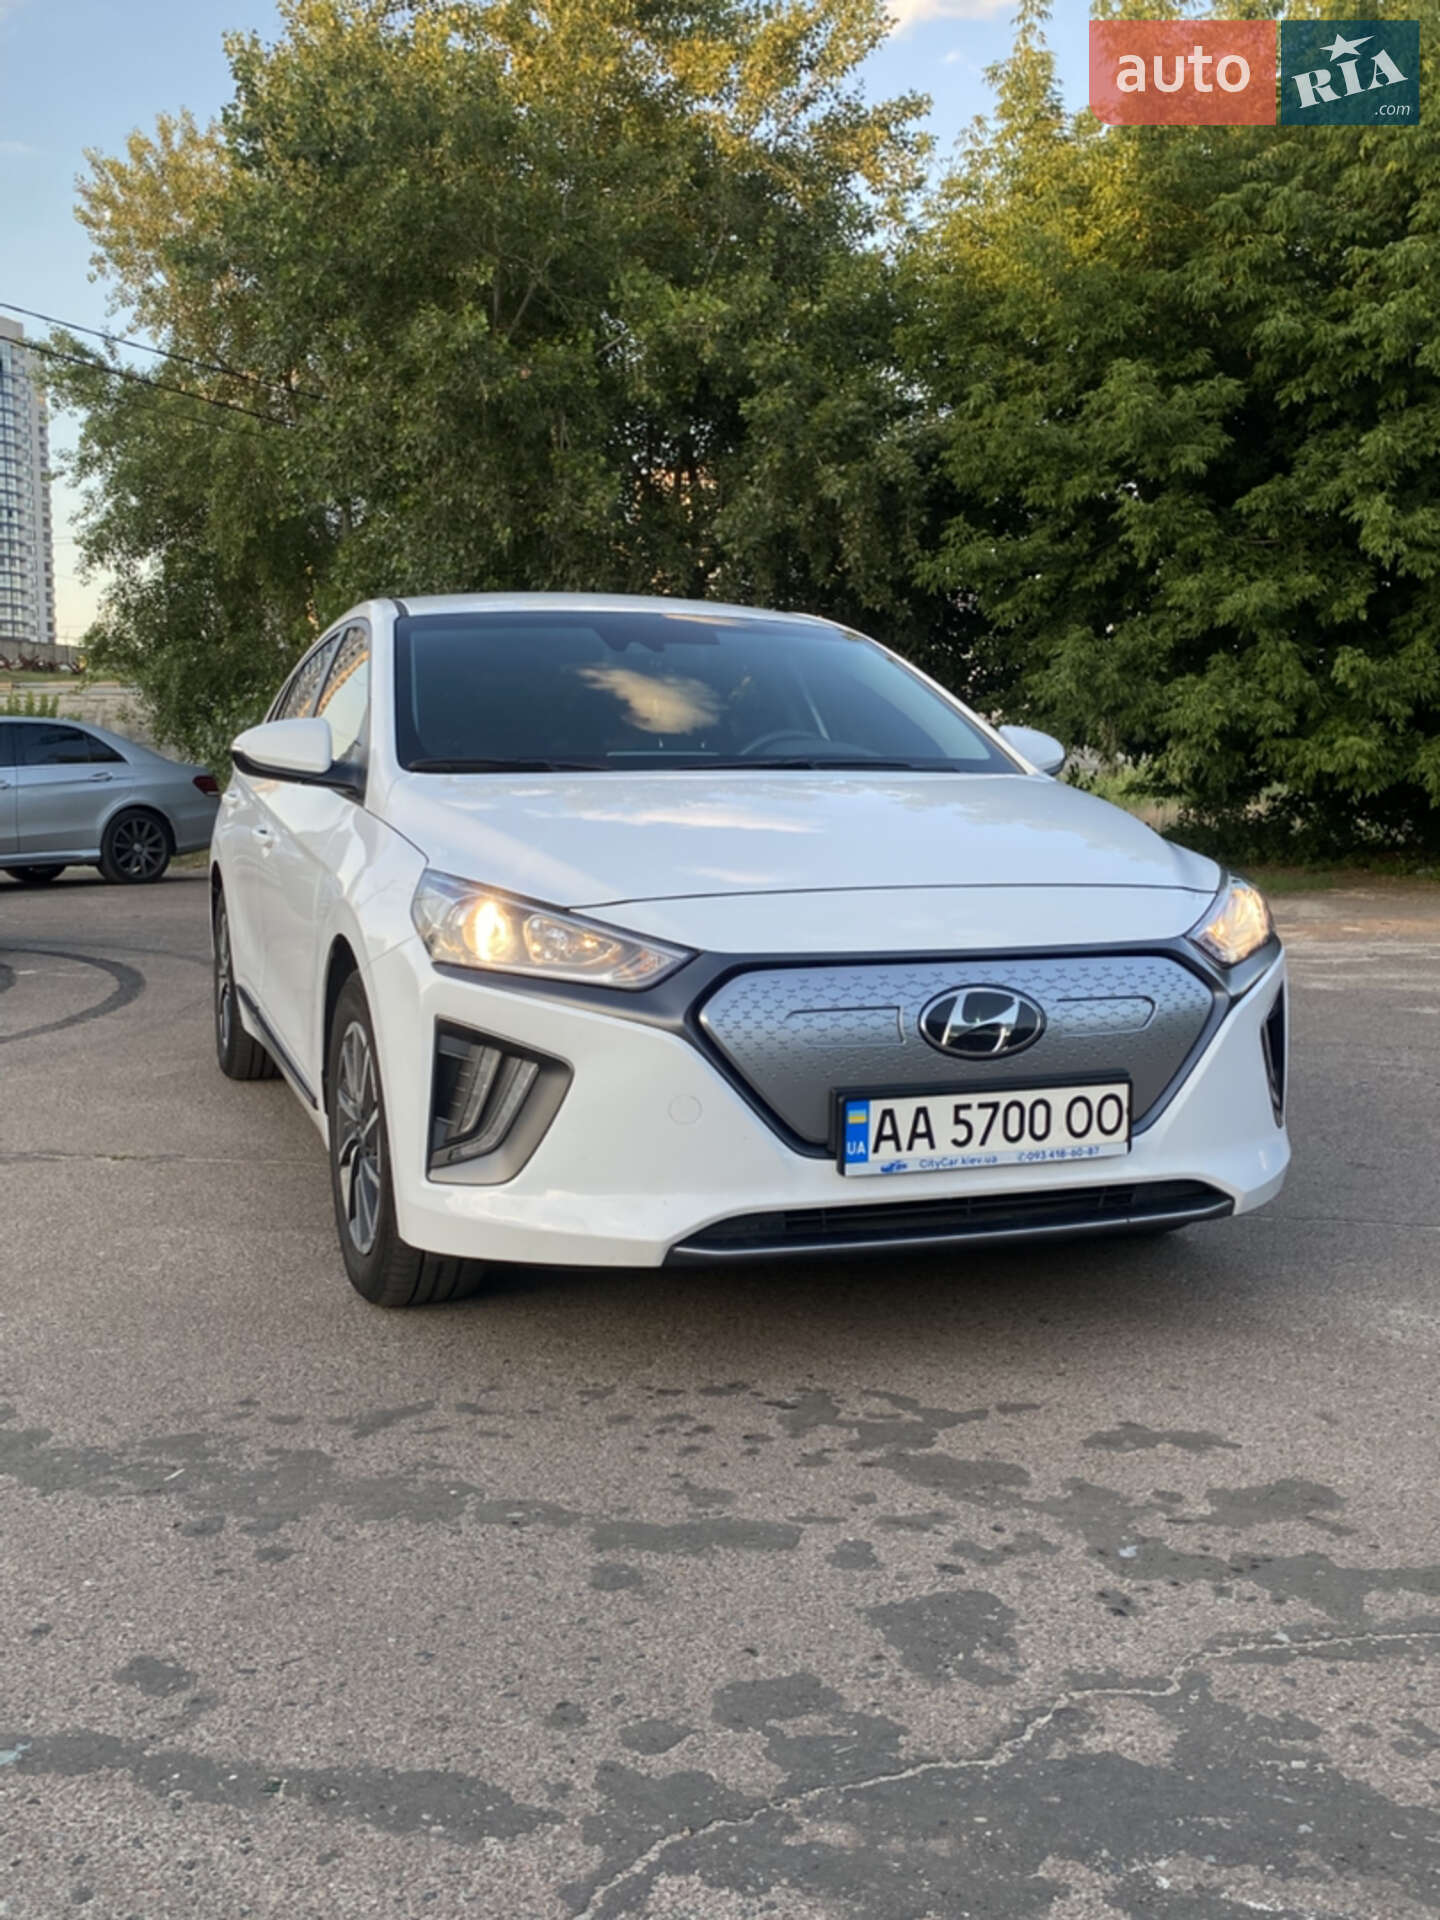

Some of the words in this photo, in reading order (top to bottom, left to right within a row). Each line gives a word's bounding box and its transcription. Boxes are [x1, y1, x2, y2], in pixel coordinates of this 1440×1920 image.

[872, 1105, 936, 1154] AA
[950, 1096, 1052, 1148] 5700
[1065, 1093, 1123, 1139] OO
[847, 1141, 866, 1155] UA
